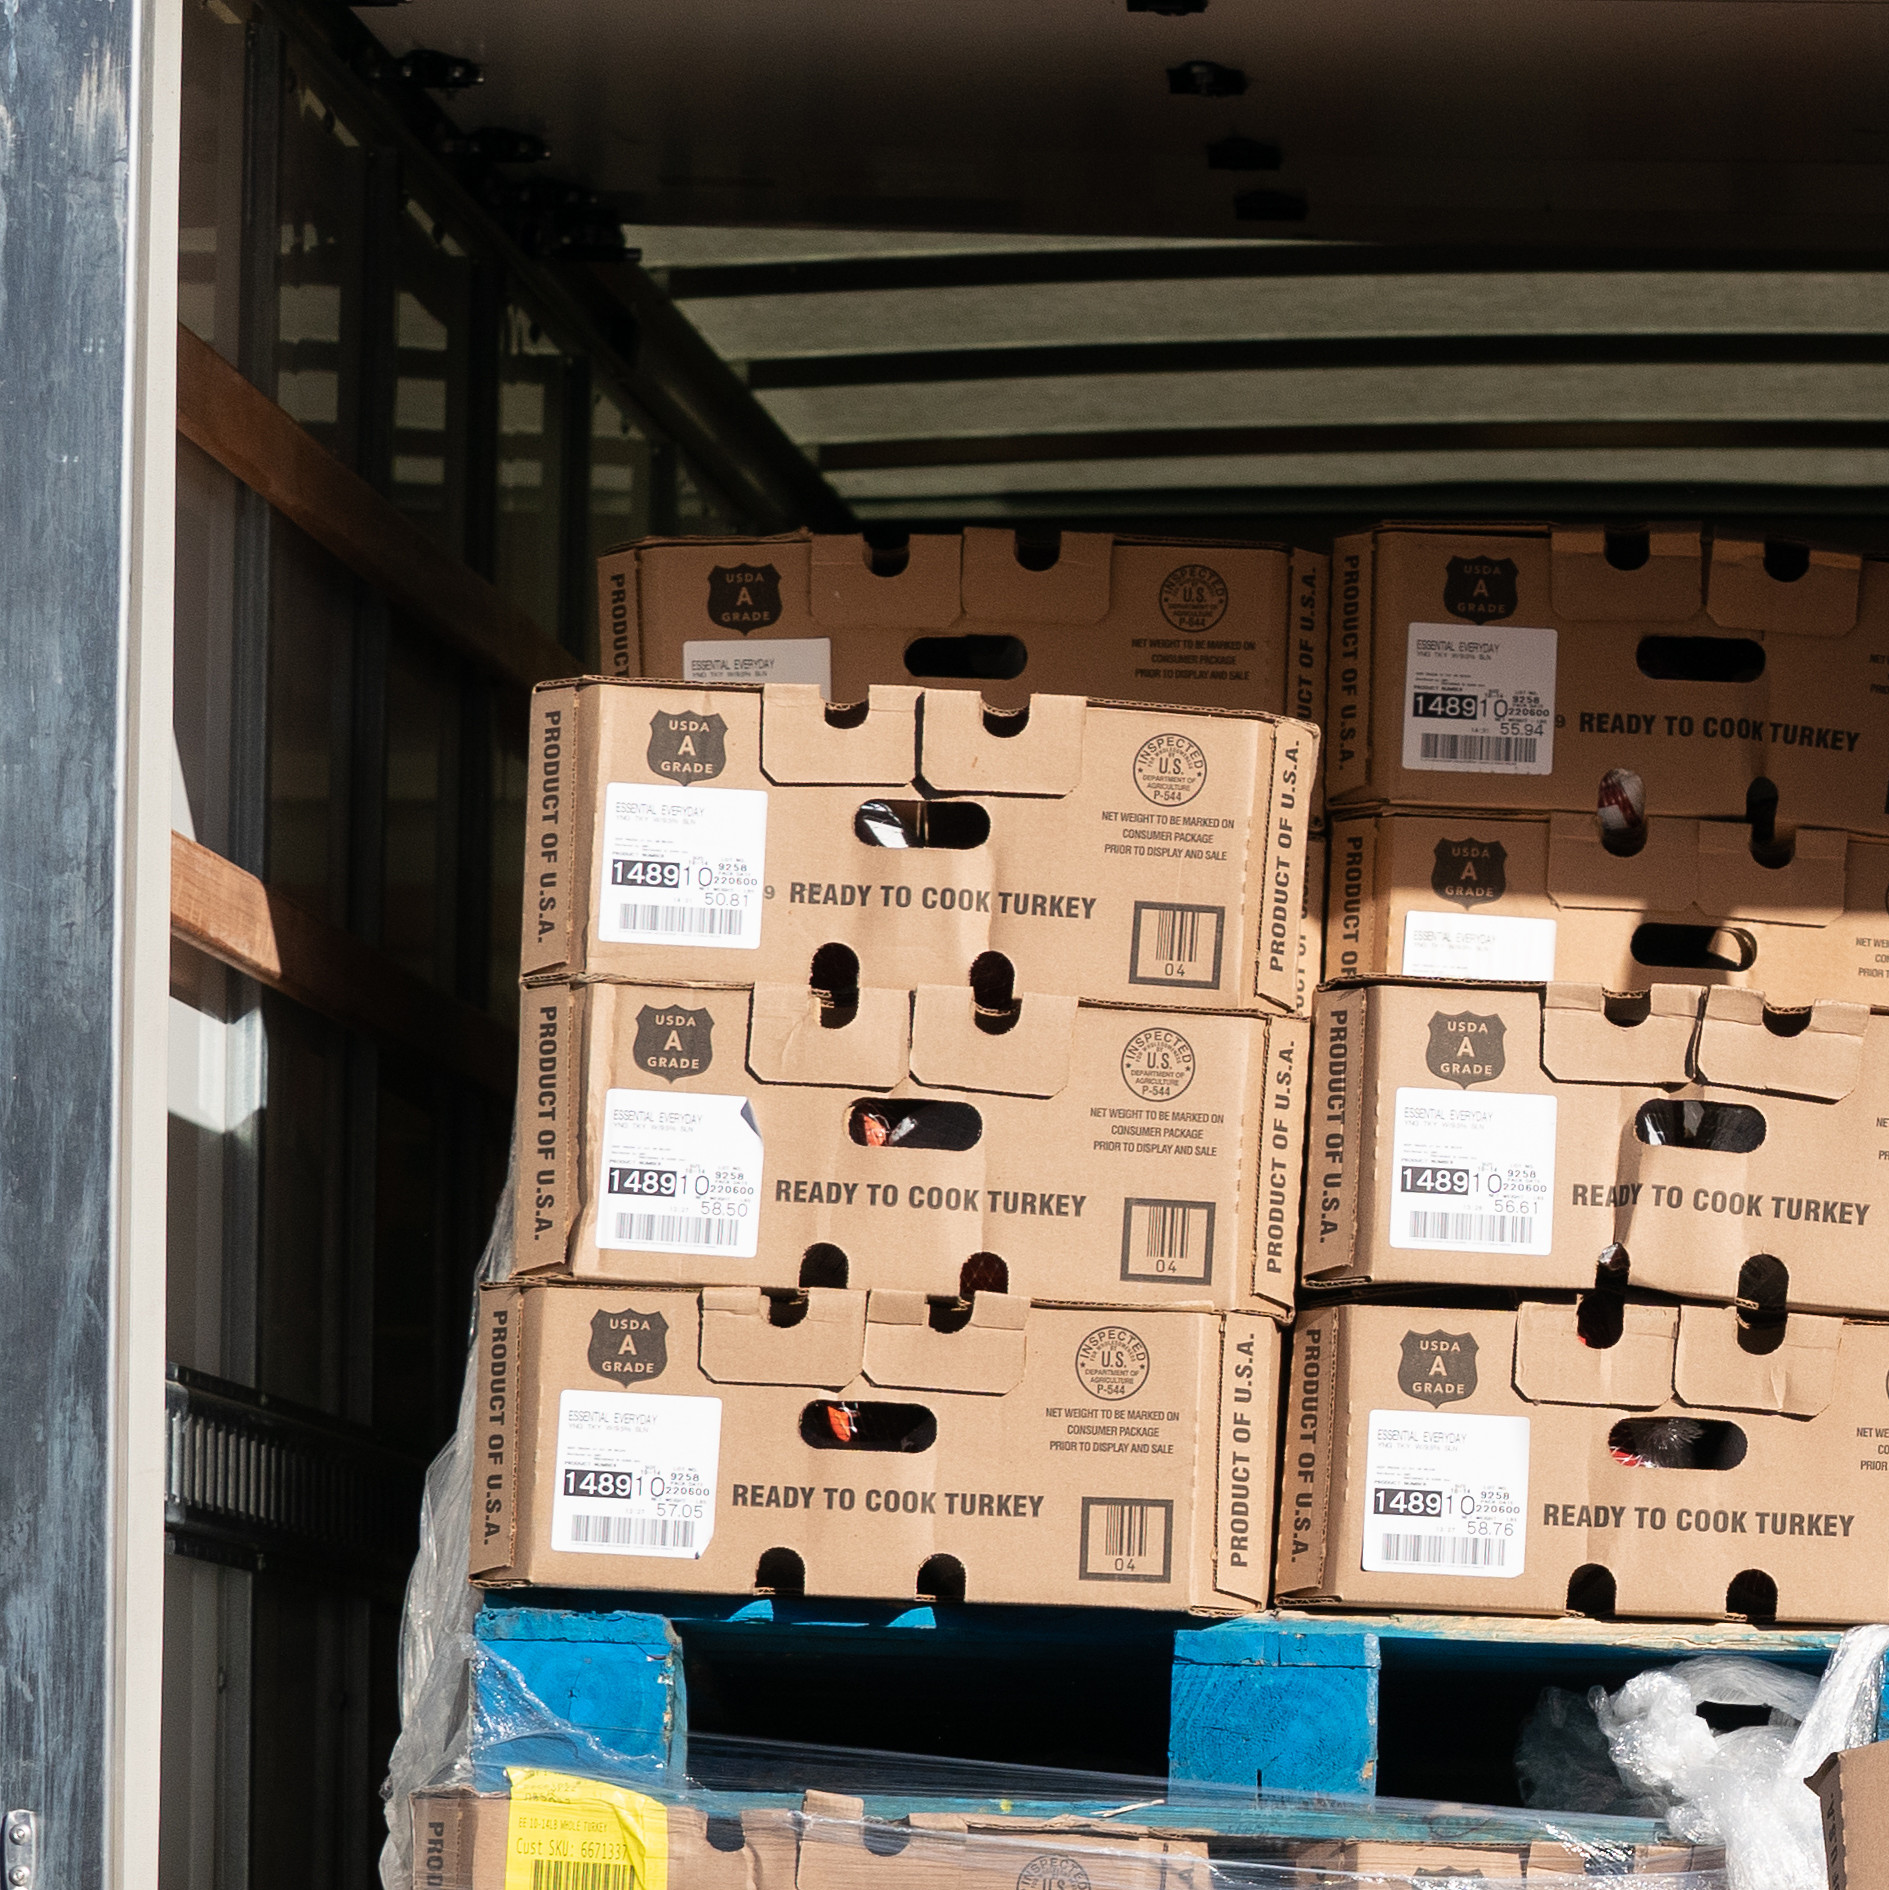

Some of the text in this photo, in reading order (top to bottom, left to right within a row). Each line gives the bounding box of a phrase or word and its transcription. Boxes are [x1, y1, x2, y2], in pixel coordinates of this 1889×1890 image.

[669, 720, 709, 732] USDA
[1501, 722, 1544, 736] 55.94
[1580, 712, 1860, 752] READY TO COOK TURKEY
[678, 736, 696, 756] A
[661, 761, 712, 773] GRADE
[1452, 847, 1489, 857] USDA
[1461, 862, 1477, 880] A
[704, 891, 750, 908] 50.81
[1445, 886, 1494, 898] GRADE
[791, 883, 1096, 919] READY TO COOK TURKEY
[656, 1015, 695, 1026] USDA
[664, 1030, 682, 1051] A
[1126, 1031, 1192, 1064] INSPECTED
[647, 1057, 699, 1069] GRADE
[1147, 1052, 1172, 1070] U.S.
[1142, 1085, 1171, 1096] P-544
[1090, 1108, 1224, 1123] NET WEIGHT TO BE MARKED ON
[533, 1007, 558, 1241] PRODUCT OF U.S.A.
[1111, 1125, 1204, 1139] CONSUMER PACKAGE
[1094, 1141, 1217, 1156] PRIOR TO DISPLAY AND SALE
[1267, 1041, 1295, 1273] PRODUCT OF U.S.A.
[715, 1171, 744, 1180] 9258
[709, 1185, 754, 1195] 220600
[776, 1180, 1086, 1216] READY TO COOK TURKEY
[701, 1201, 748, 1217] 58.50
[1493, 1199, 1540, 1215] 56.61
[1571, 1182, 1869, 1225] READY TO COOK TURKEY
[1155, 1259, 1177, 1273] 04
[733, 1484, 1044, 1517] READY TO COOK TURKEY
[656, 1503, 704, 1519] 57.05
[1544, 1504, 1854, 1536] READY TO COOK TURKEY
[1466, 1521, 1514, 1537] 58.76
[561, 1820, 580, 1831] WHOLE
[583, 1821, 607, 1832] TURKEY
[516, 1837, 627, 1860] Cust SKU: 6671337
